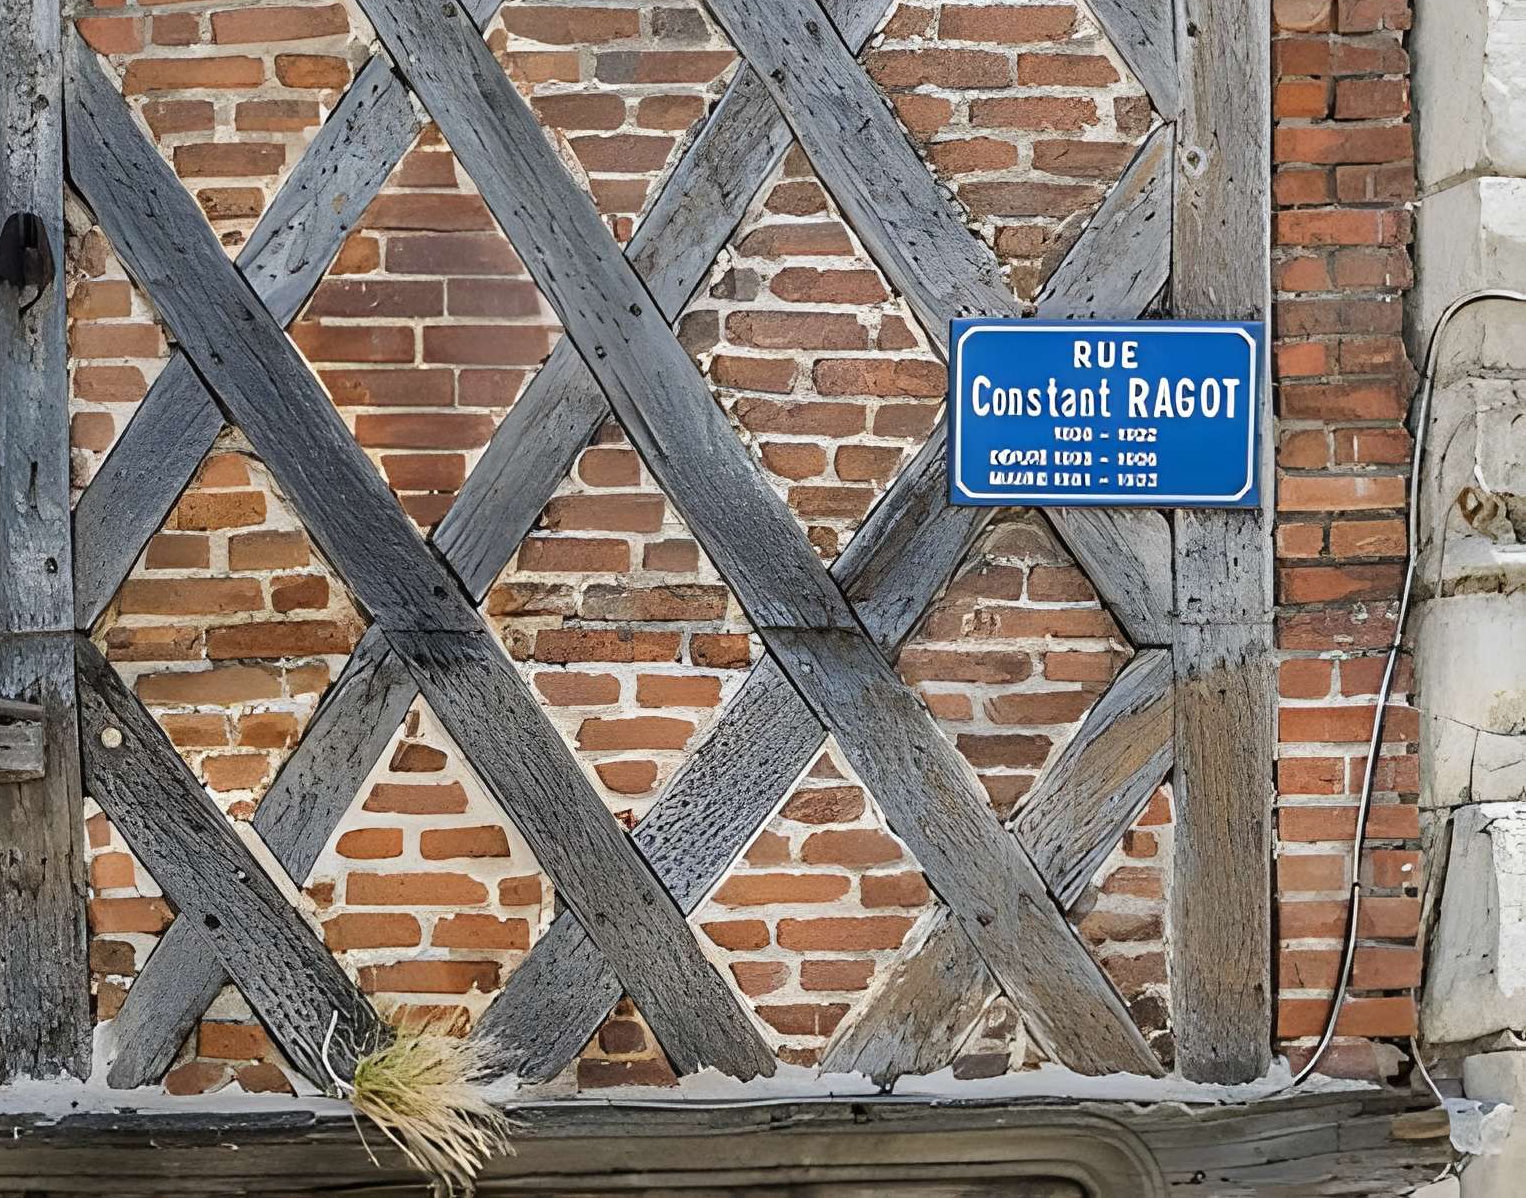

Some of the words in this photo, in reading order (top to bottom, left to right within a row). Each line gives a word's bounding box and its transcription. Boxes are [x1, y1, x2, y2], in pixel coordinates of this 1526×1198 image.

[1073, 340, 1139, 369] RUE
[972, 375, 1111, 418] Constant
[1128, 377, 1240, 419] RAGOT
